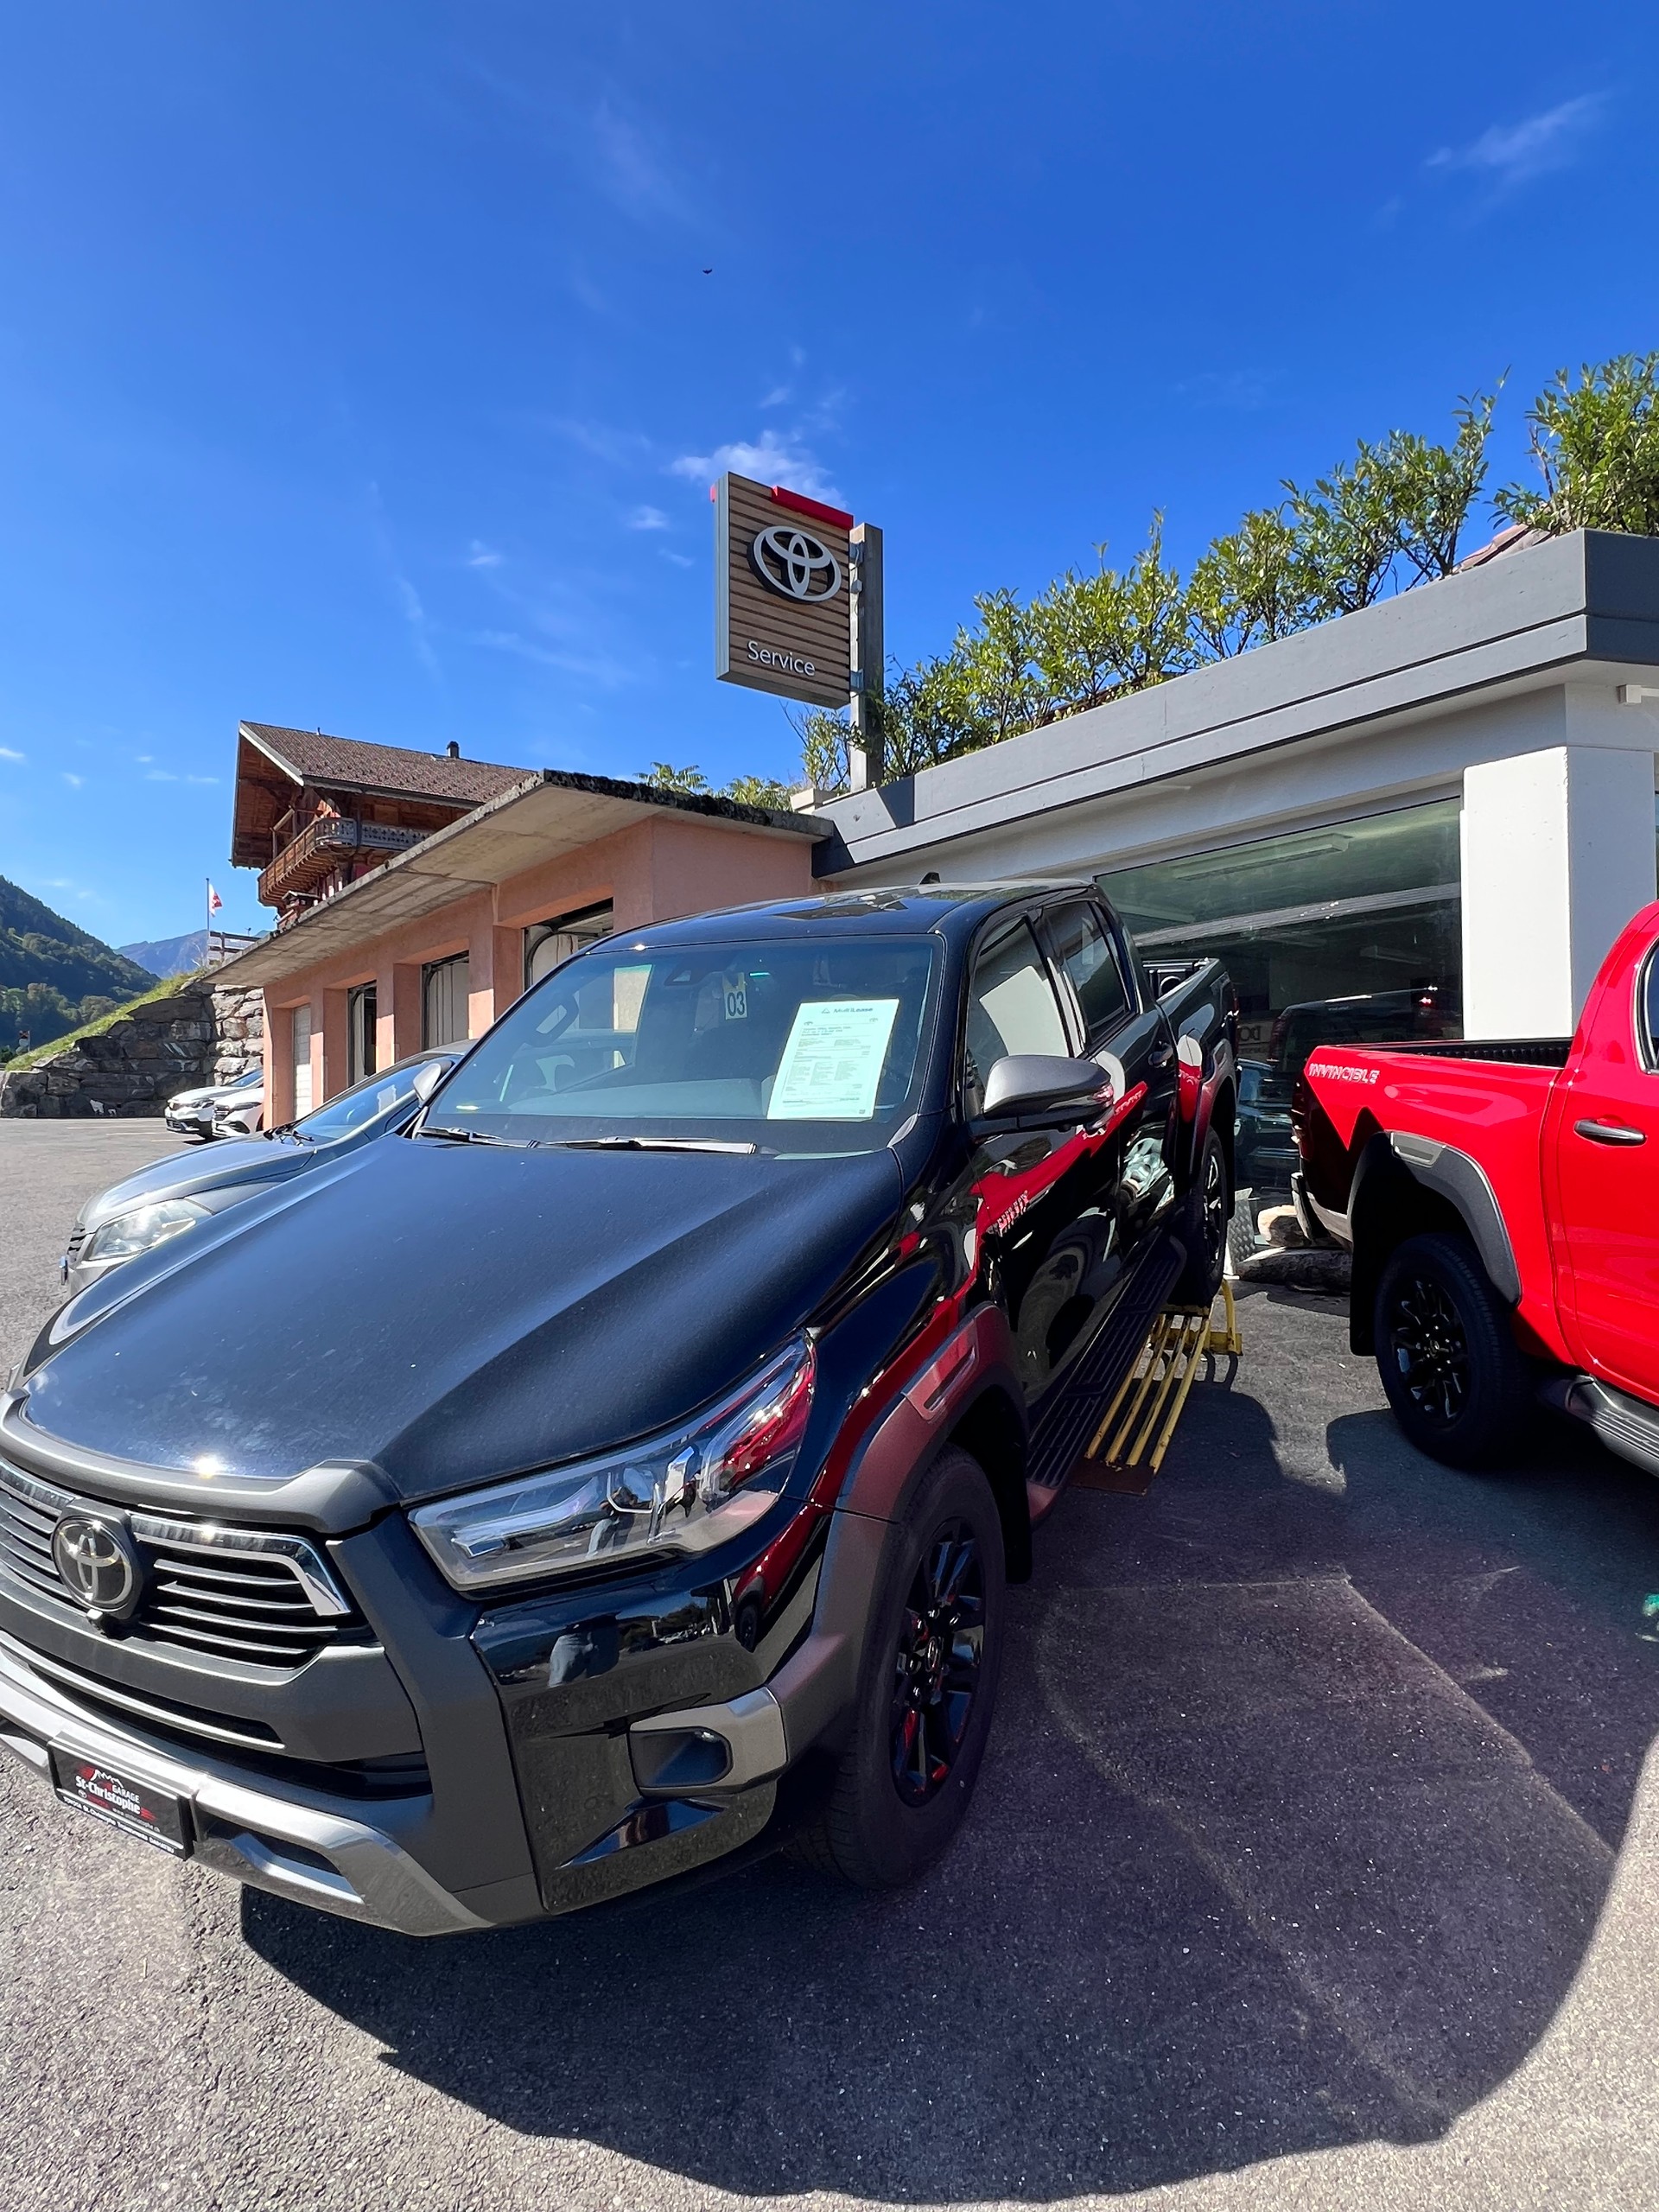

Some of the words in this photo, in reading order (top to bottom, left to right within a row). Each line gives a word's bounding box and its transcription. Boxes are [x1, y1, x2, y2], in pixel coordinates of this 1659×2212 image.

[747, 640, 816, 677] Service
[727, 991, 745, 1017] 03
[1308, 1063, 1381, 1084] INVINCIBLE
[75, 1775, 141, 1815] St-Christophe
[111, 1784, 141, 1804] GARAGE
